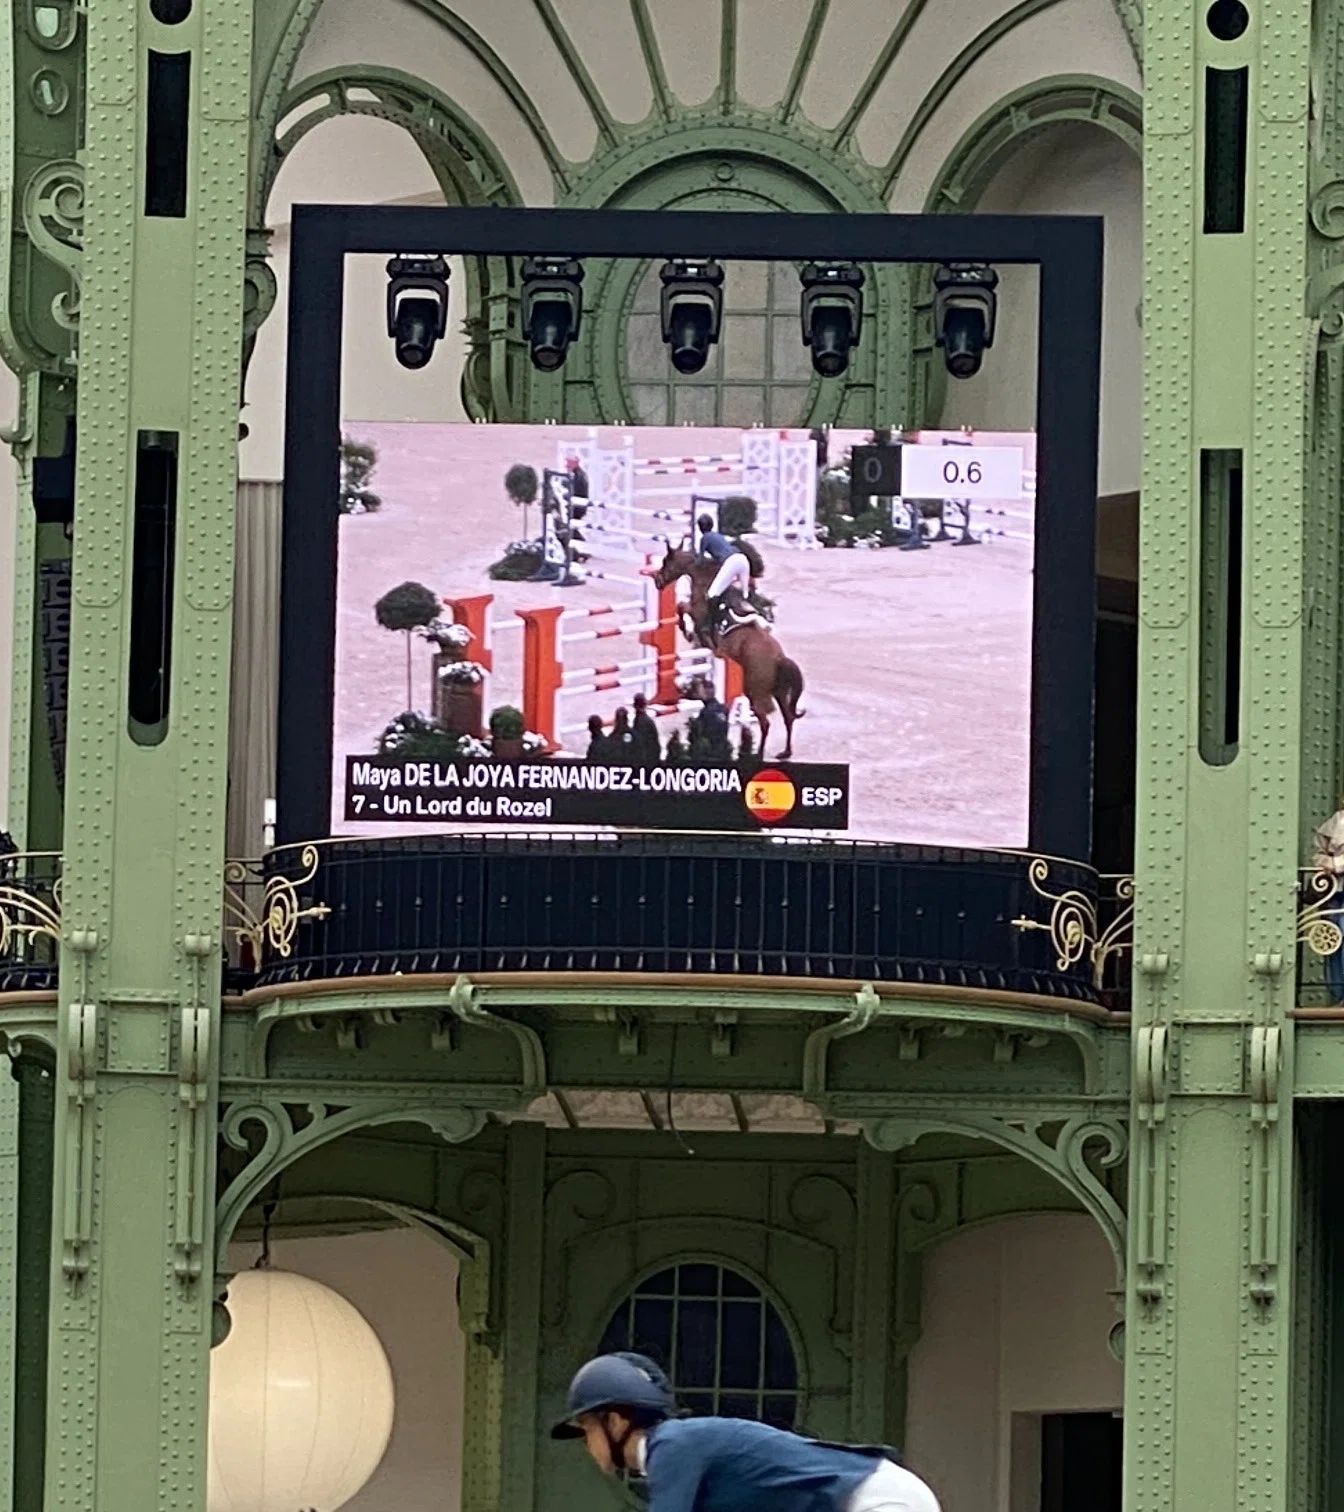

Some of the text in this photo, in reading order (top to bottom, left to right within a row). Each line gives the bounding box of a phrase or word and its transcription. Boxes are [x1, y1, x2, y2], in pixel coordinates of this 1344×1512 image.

[943, 460, 982, 484] 0.6
[352, 761, 742, 793] Maya DE LA JOYA FERNANDEZ-LONGORIA
[352, 794, 366, 814] 7
[383, 795, 411, 815] Un
[415, 796, 462, 816] Lord
[466, 797, 492, 816] du
[496, 797, 552, 817] Rozel
[801, 786, 843, 806] ESP
